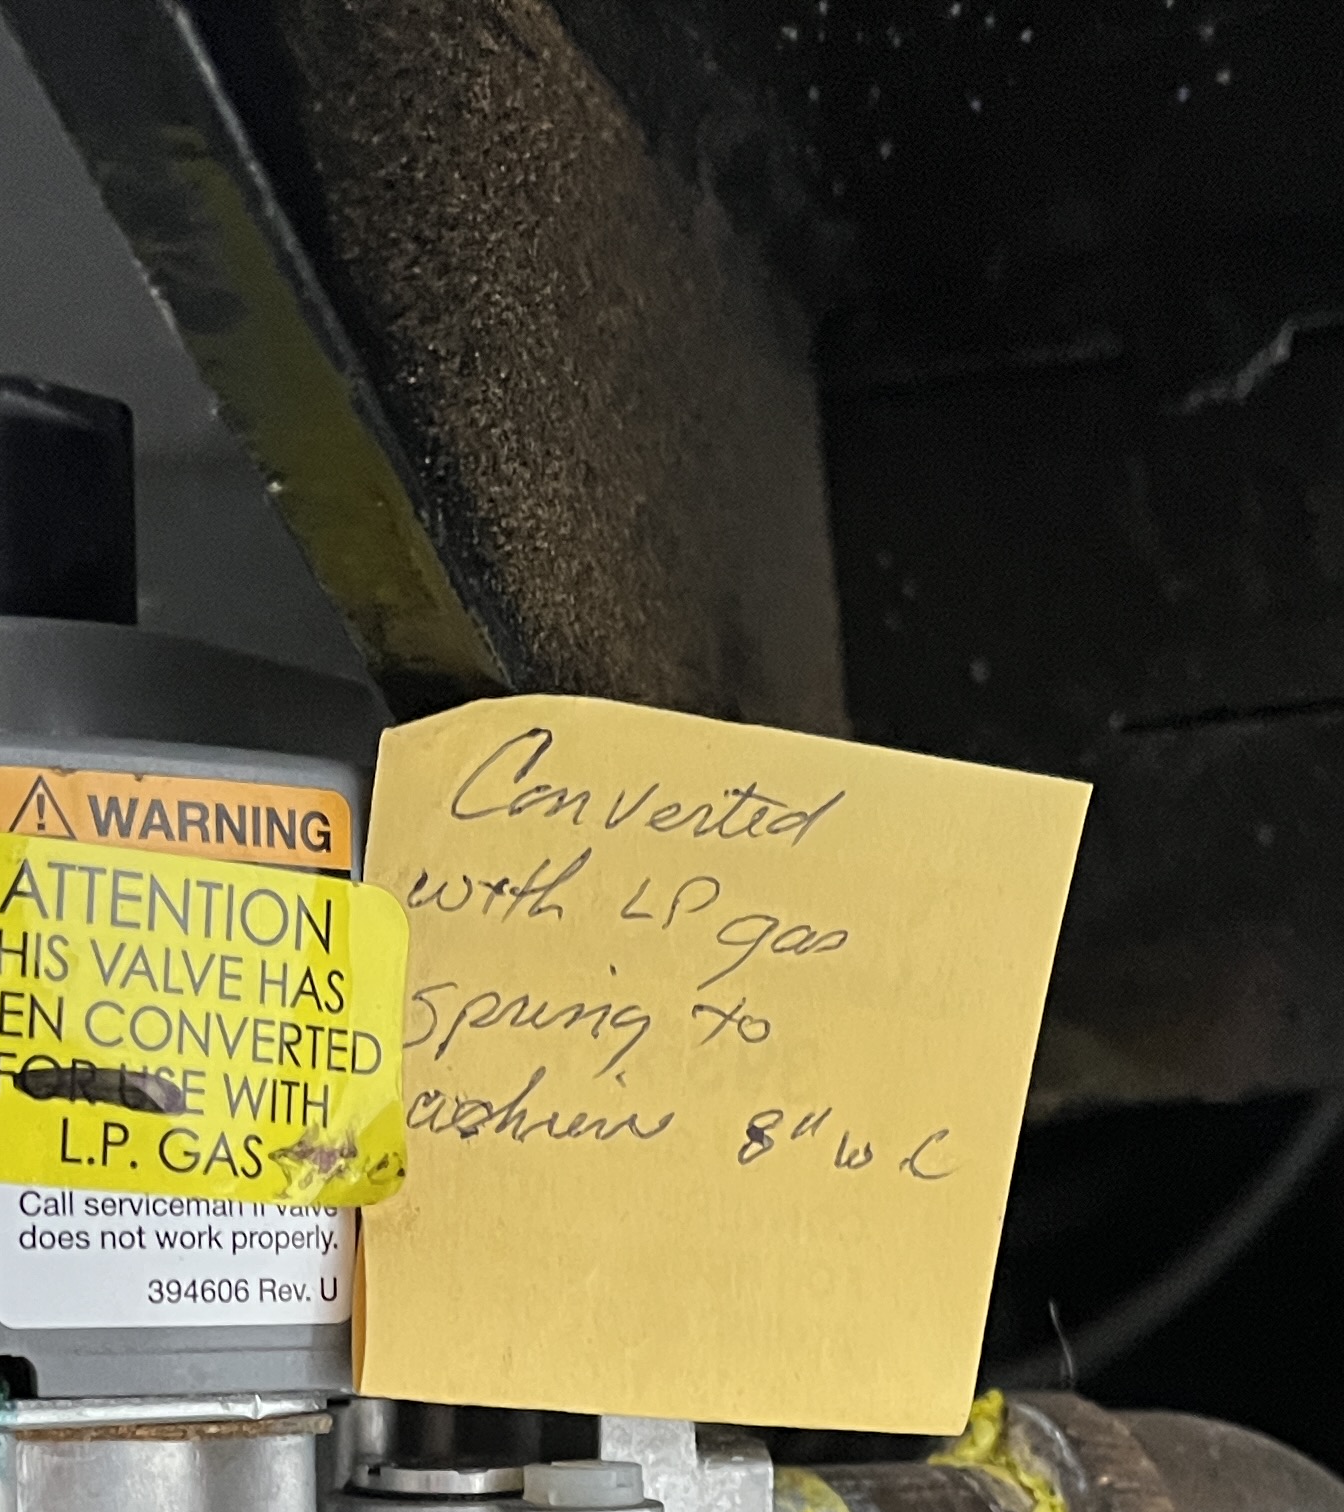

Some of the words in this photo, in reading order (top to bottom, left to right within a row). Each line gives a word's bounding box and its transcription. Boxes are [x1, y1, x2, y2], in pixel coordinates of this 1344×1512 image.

[451, 727, 846, 847] Converted
[87, 794, 332, 853] WARNING
[621, 876, 721, 930] LP
[697, 914, 849, 991] gas
[90, 938, 244, 1002] VALVE
[260, 959, 345, 1015] HAS
[84, 1000, 383, 1076] CONVERTED
[223, 1072, 331, 1129] WITH
[60, 1117, 138, 1170] L.P.
[158, 1127, 263, 1180] GAS
[18, 1190, 74, 1218] Call
[18, 1225, 90, 1251] does
[100, 1227, 147, 1251] not
[155, 1224, 224, 1250] work
[231, 1224, 339, 1256] properly.
[146, 1279, 250, 1305] 394606
[258, 1278, 312, 1304] Rev.
[320, 1277, 339, 1303] U
